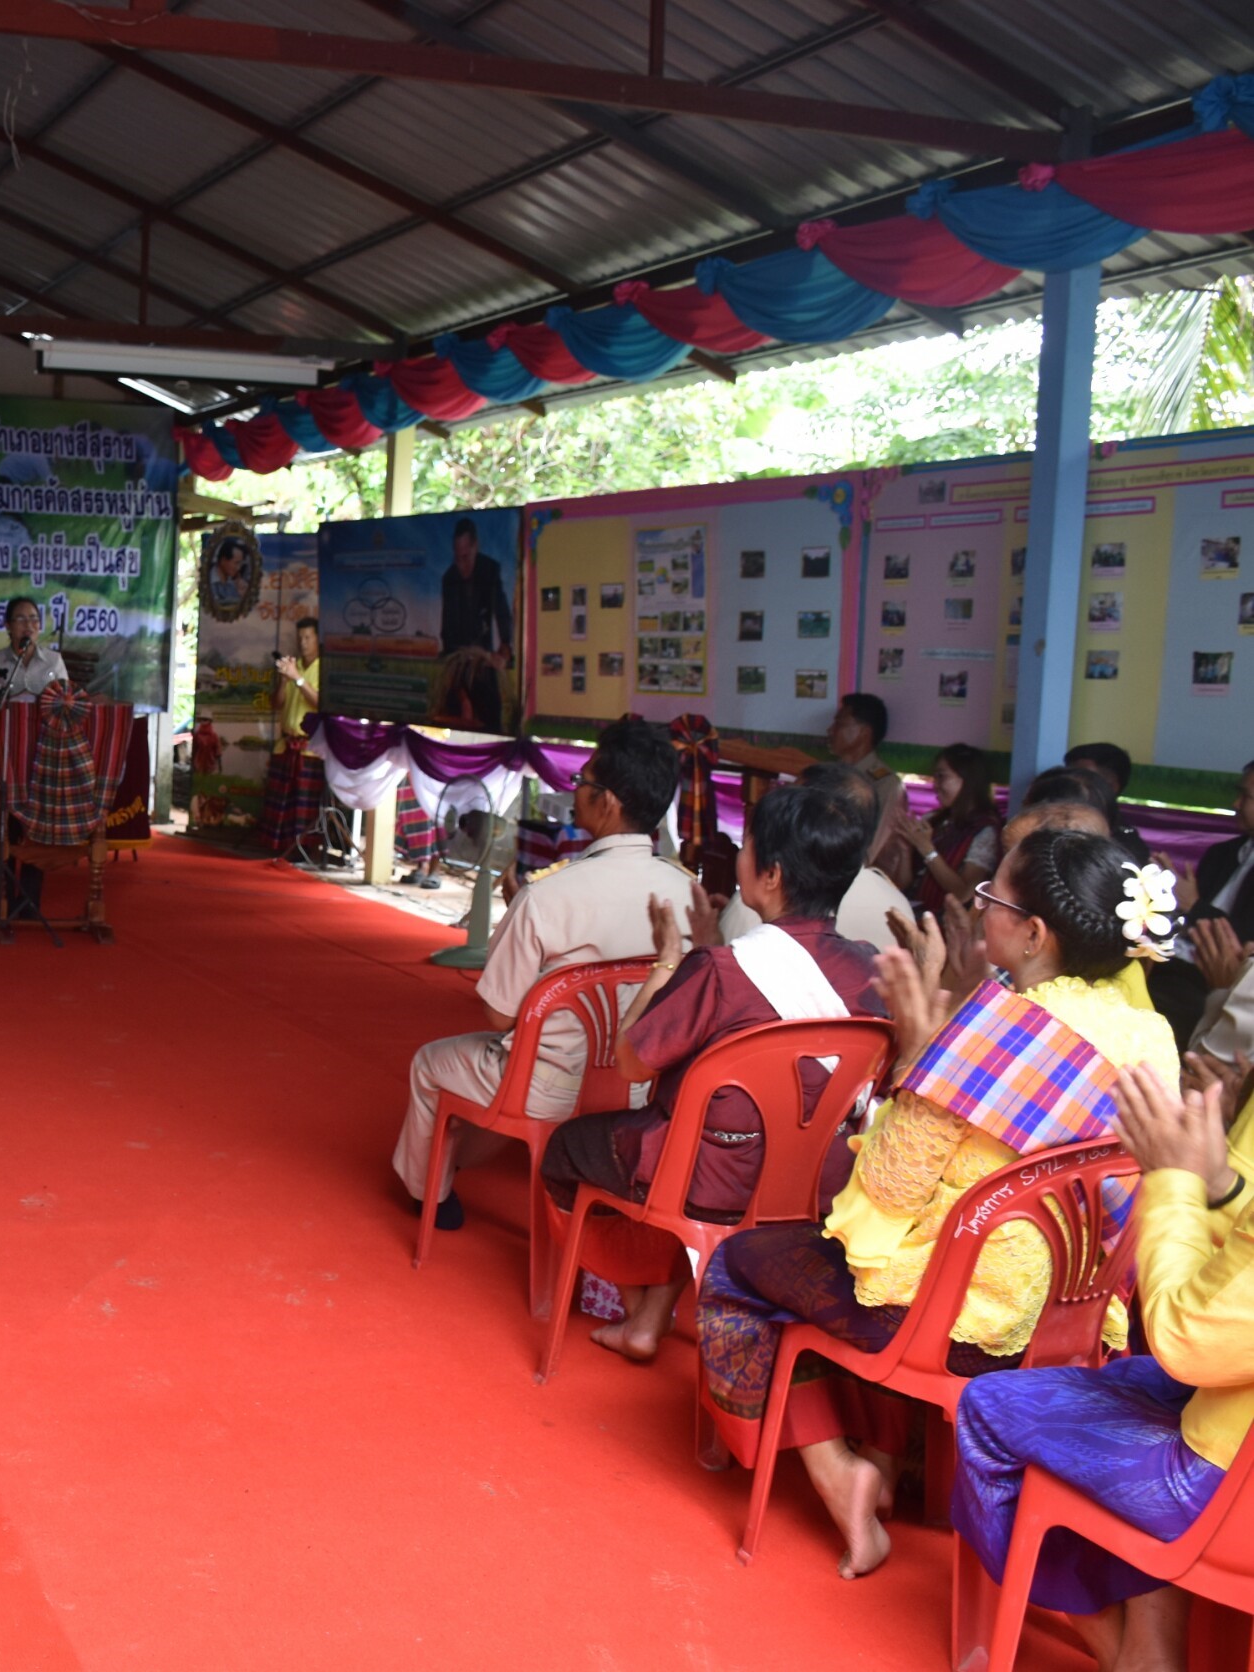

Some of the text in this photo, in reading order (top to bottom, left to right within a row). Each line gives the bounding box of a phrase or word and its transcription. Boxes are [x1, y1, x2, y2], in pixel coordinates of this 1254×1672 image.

[18, 531, 141, 591] อยู่เย็นเป็นสุข
[74, 605, 120, 636] 2560
[953, 1182, 1015, 1239] โครงการ
